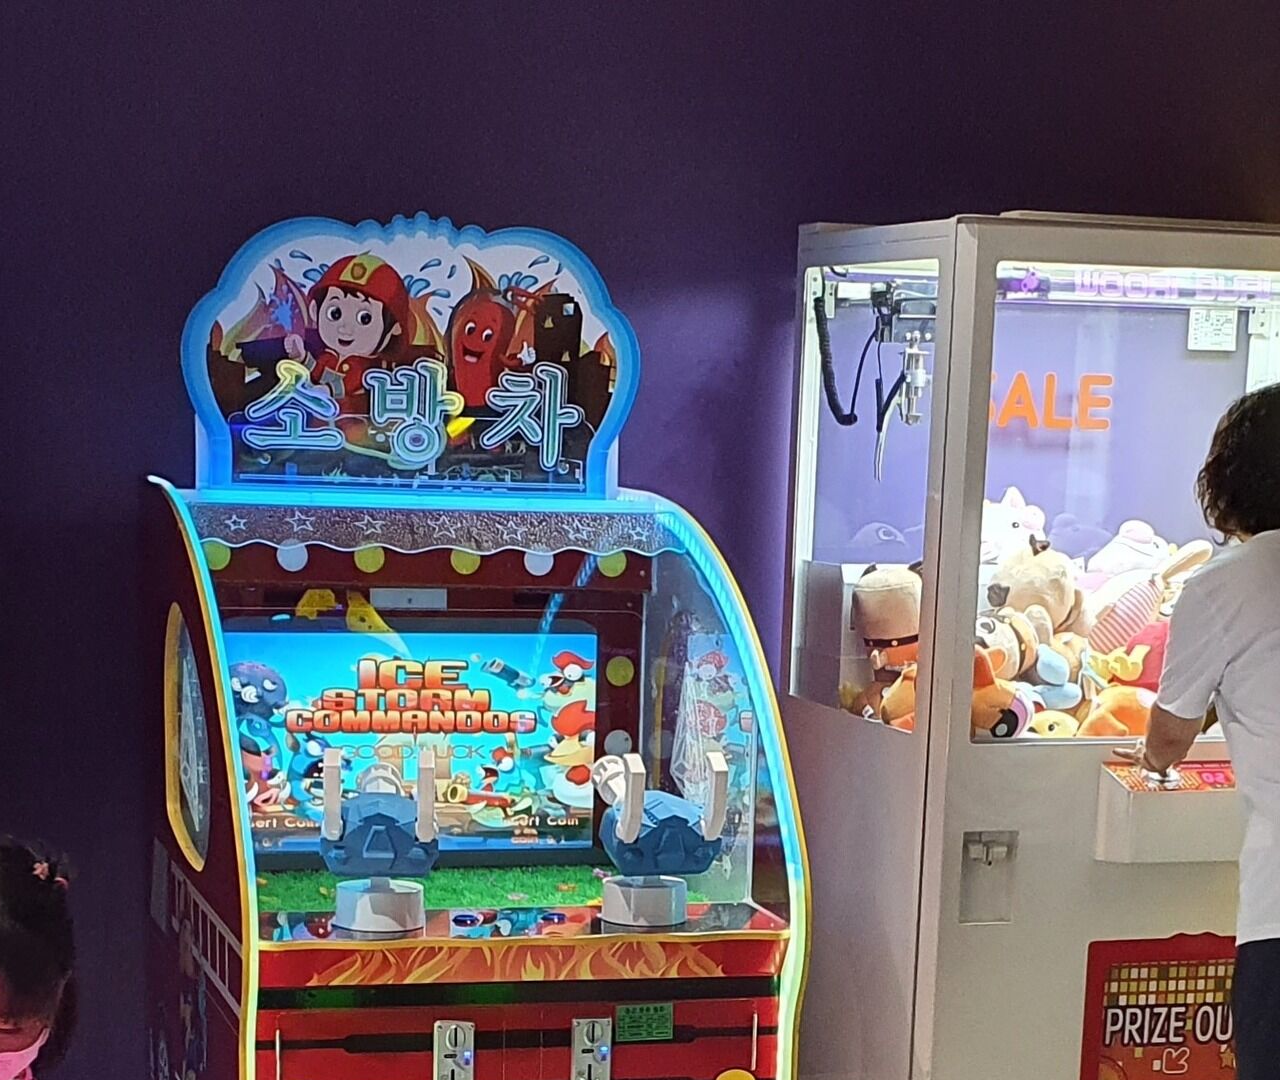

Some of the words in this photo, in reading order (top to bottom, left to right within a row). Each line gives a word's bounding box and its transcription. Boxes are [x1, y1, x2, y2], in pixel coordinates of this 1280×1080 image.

[241, 358, 582, 471] 소방차
[990, 371, 1114, 430] ALE
[358, 658, 469, 689] ICE
[322, 688, 491, 711] STORM
[286, 709, 538, 734] COMMANDOS
[547, 815, 579, 826] Coin
[1105, 1006, 1186, 1045] PRIZE
[1195, 1005, 1234, 1042] OU
